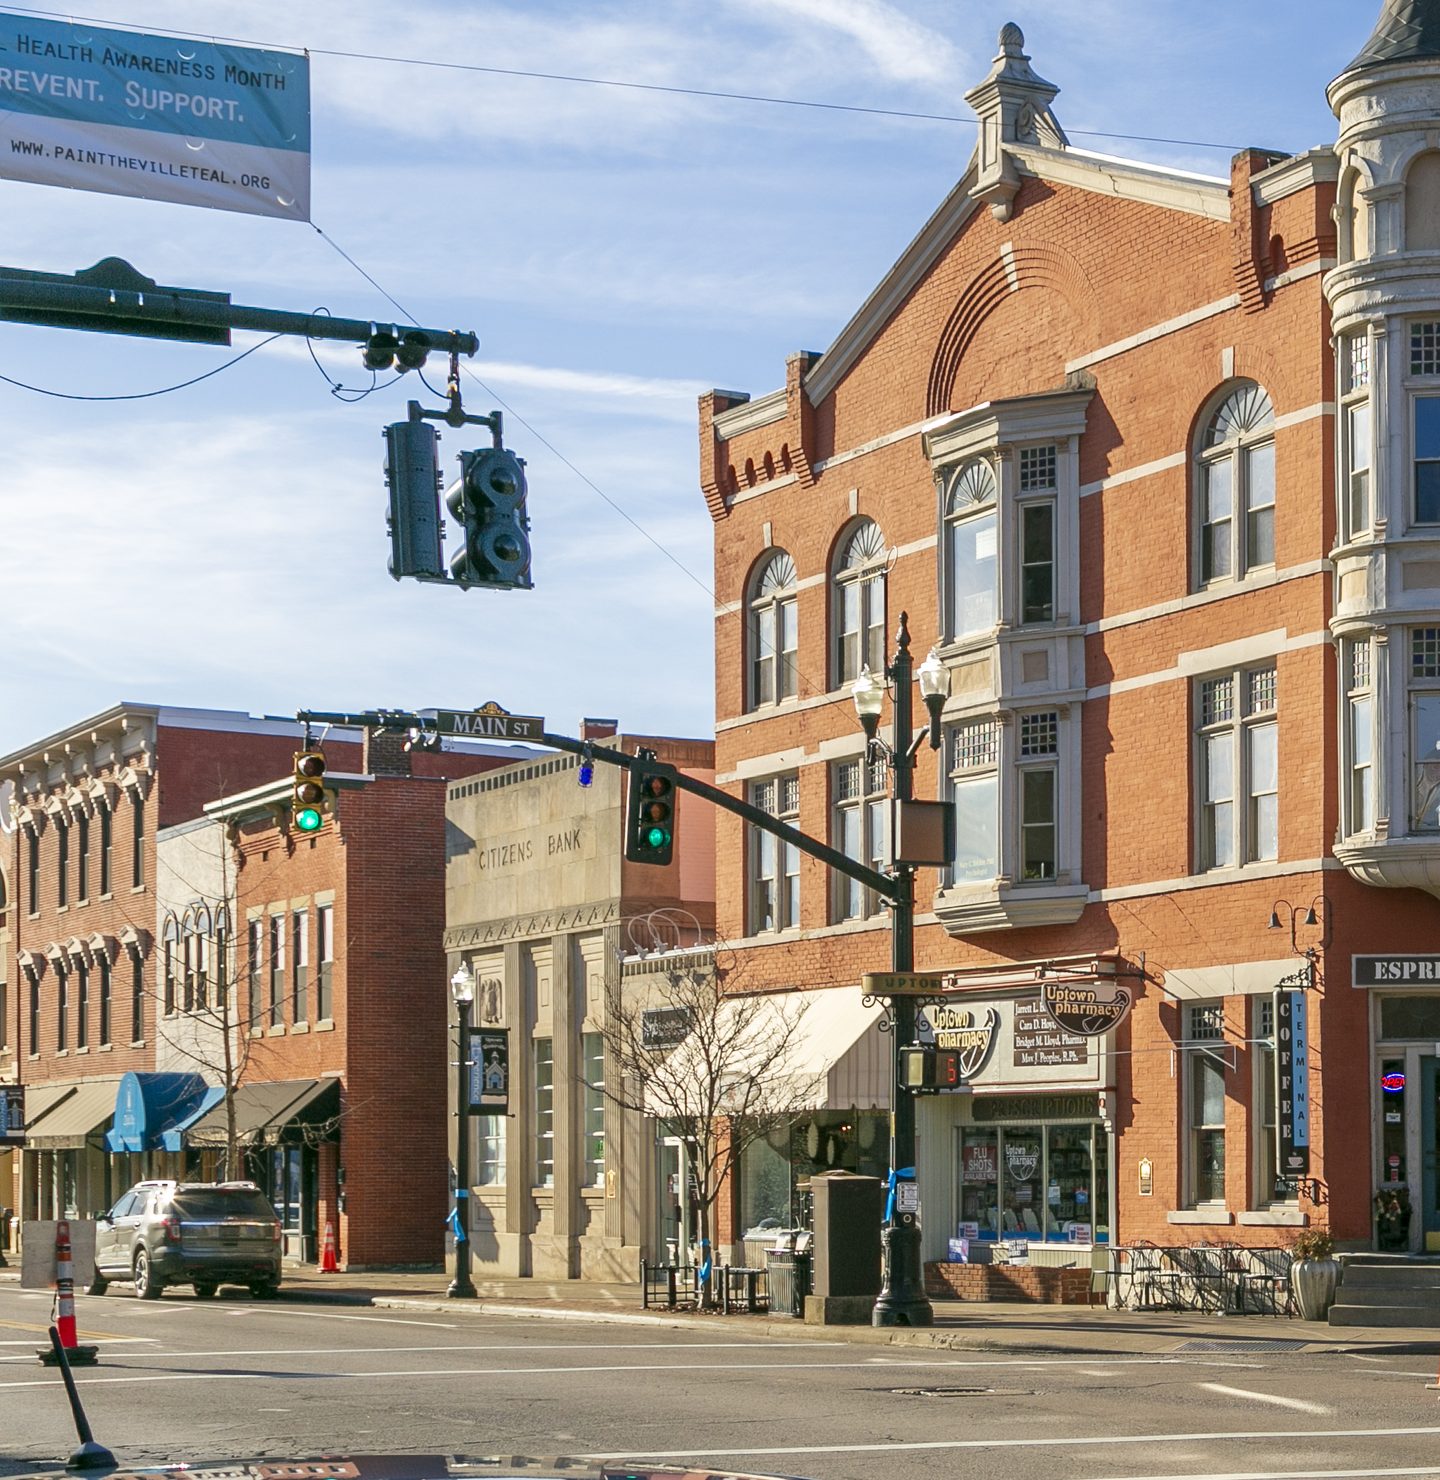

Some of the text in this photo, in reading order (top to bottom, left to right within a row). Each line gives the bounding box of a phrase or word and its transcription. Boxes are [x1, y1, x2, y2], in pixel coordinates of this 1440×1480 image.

[17, 34, 285, 90] HEALTH AWARENESS MONTH
[11, 140, 271, 189] WWW.PAINTTHEVILLETEAL.ORG
[453, 714, 530, 736] MAIN ST
[479, 829, 582, 870] CITIZENS BANK
[1046, 986, 1095, 1003] Uptown
[933, 1007, 970, 1030] Uptown
[1055, 1001, 1120, 1018] pharmacy
[947, 1058, 956, 1082] 5
[1280, 1003, 1291, 1138] COFFEE
[1296, 1004, 1305, 1138] TERMINAL
[991, 1096, 1095, 1117] PRESCRIPTIONS
[973, 1147, 988, 1159] FLU
[968, 1159, 993, 1172] SHOTS
